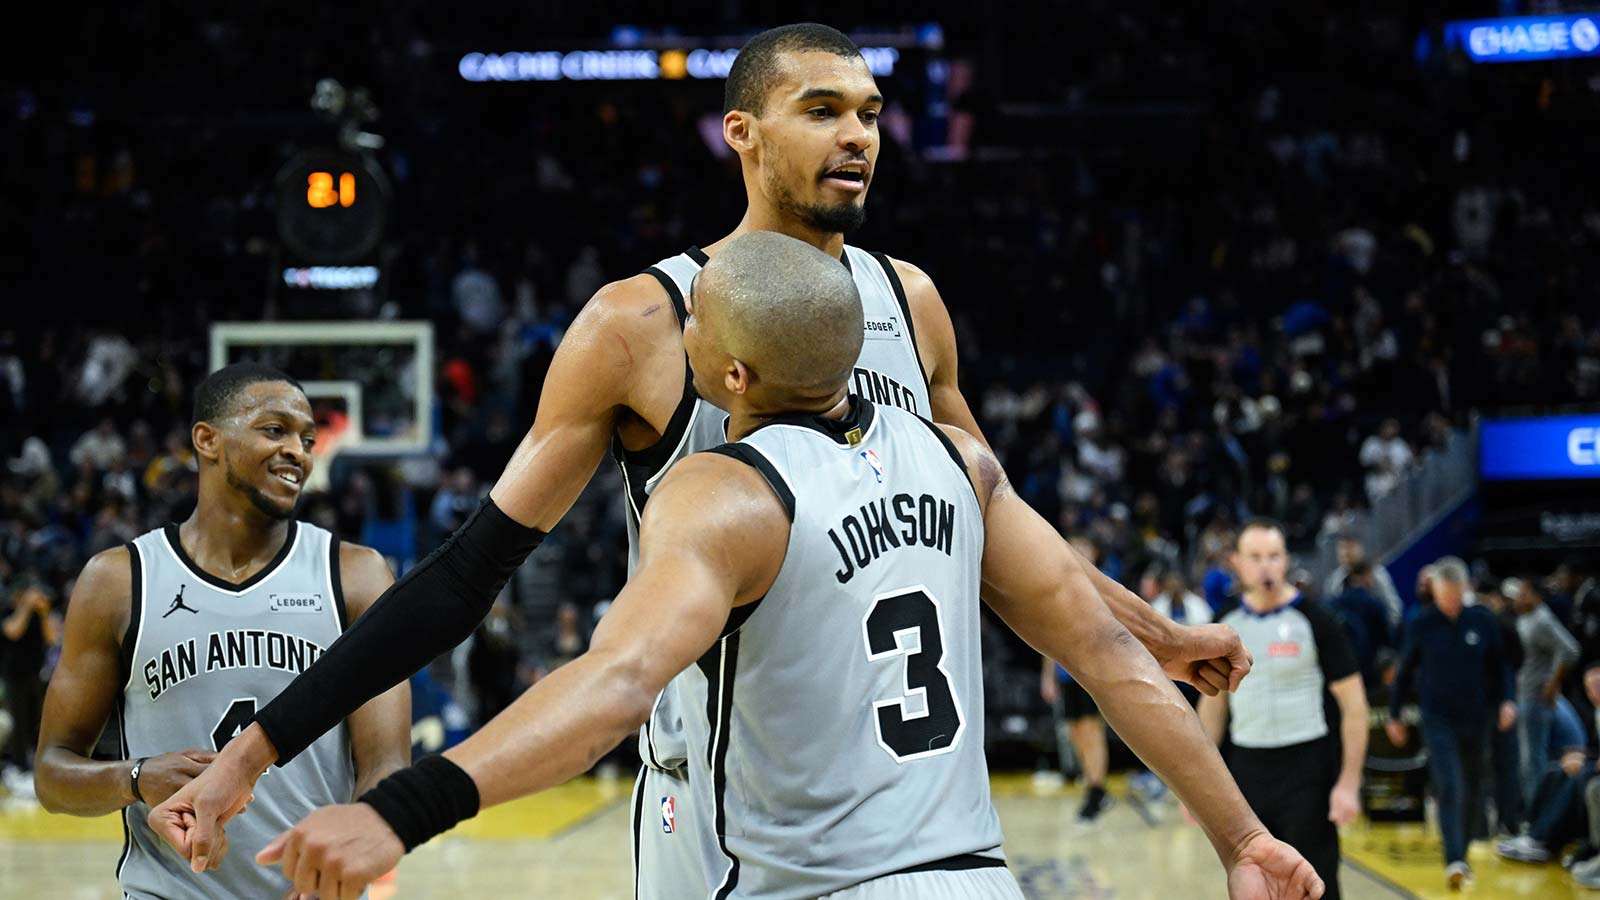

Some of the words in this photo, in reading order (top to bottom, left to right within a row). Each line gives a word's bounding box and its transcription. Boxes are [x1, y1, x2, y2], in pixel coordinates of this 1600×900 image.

[1469, 22, 1570, 56] CHASE
[276, 599, 315, 607] LEDGER
[143, 638, 197, 702] SAN
[205, 630, 327, 675] ANTONI
[862, 584, 966, 763] 3
